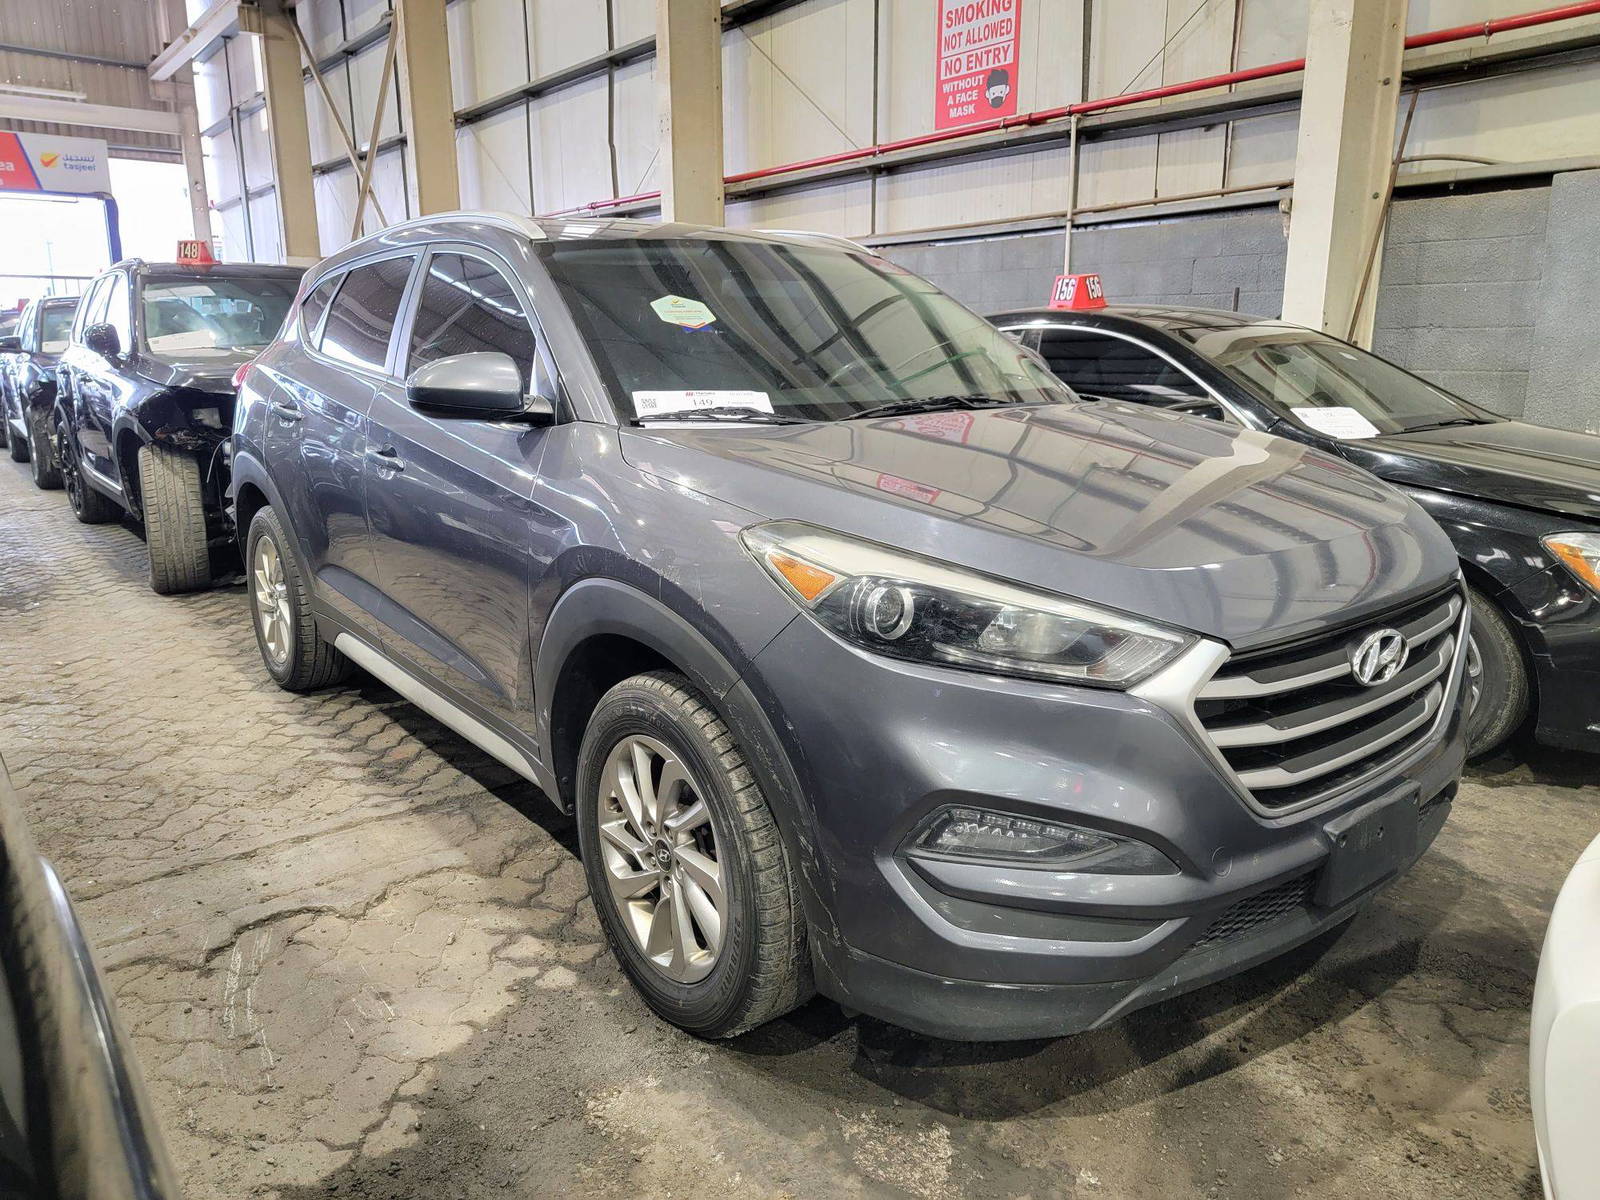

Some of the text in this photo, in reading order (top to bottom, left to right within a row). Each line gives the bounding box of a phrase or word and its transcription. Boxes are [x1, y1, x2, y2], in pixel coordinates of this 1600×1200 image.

[945, 0, 1012, 29] SMOKING
[943, 18, 1012, 52] NOT ALLOWED
[944, 44, 1011, 77] NO ENTRY
[942, 74, 985, 94] WITHOUT
[946, 89, 978, 107] A FACE
[949, 104, 975, 119] MASK
[179, 242, 198, 258] 148
[1054, 278, 1076, 301] 156
[1086, 276, 1102, 300] 156
